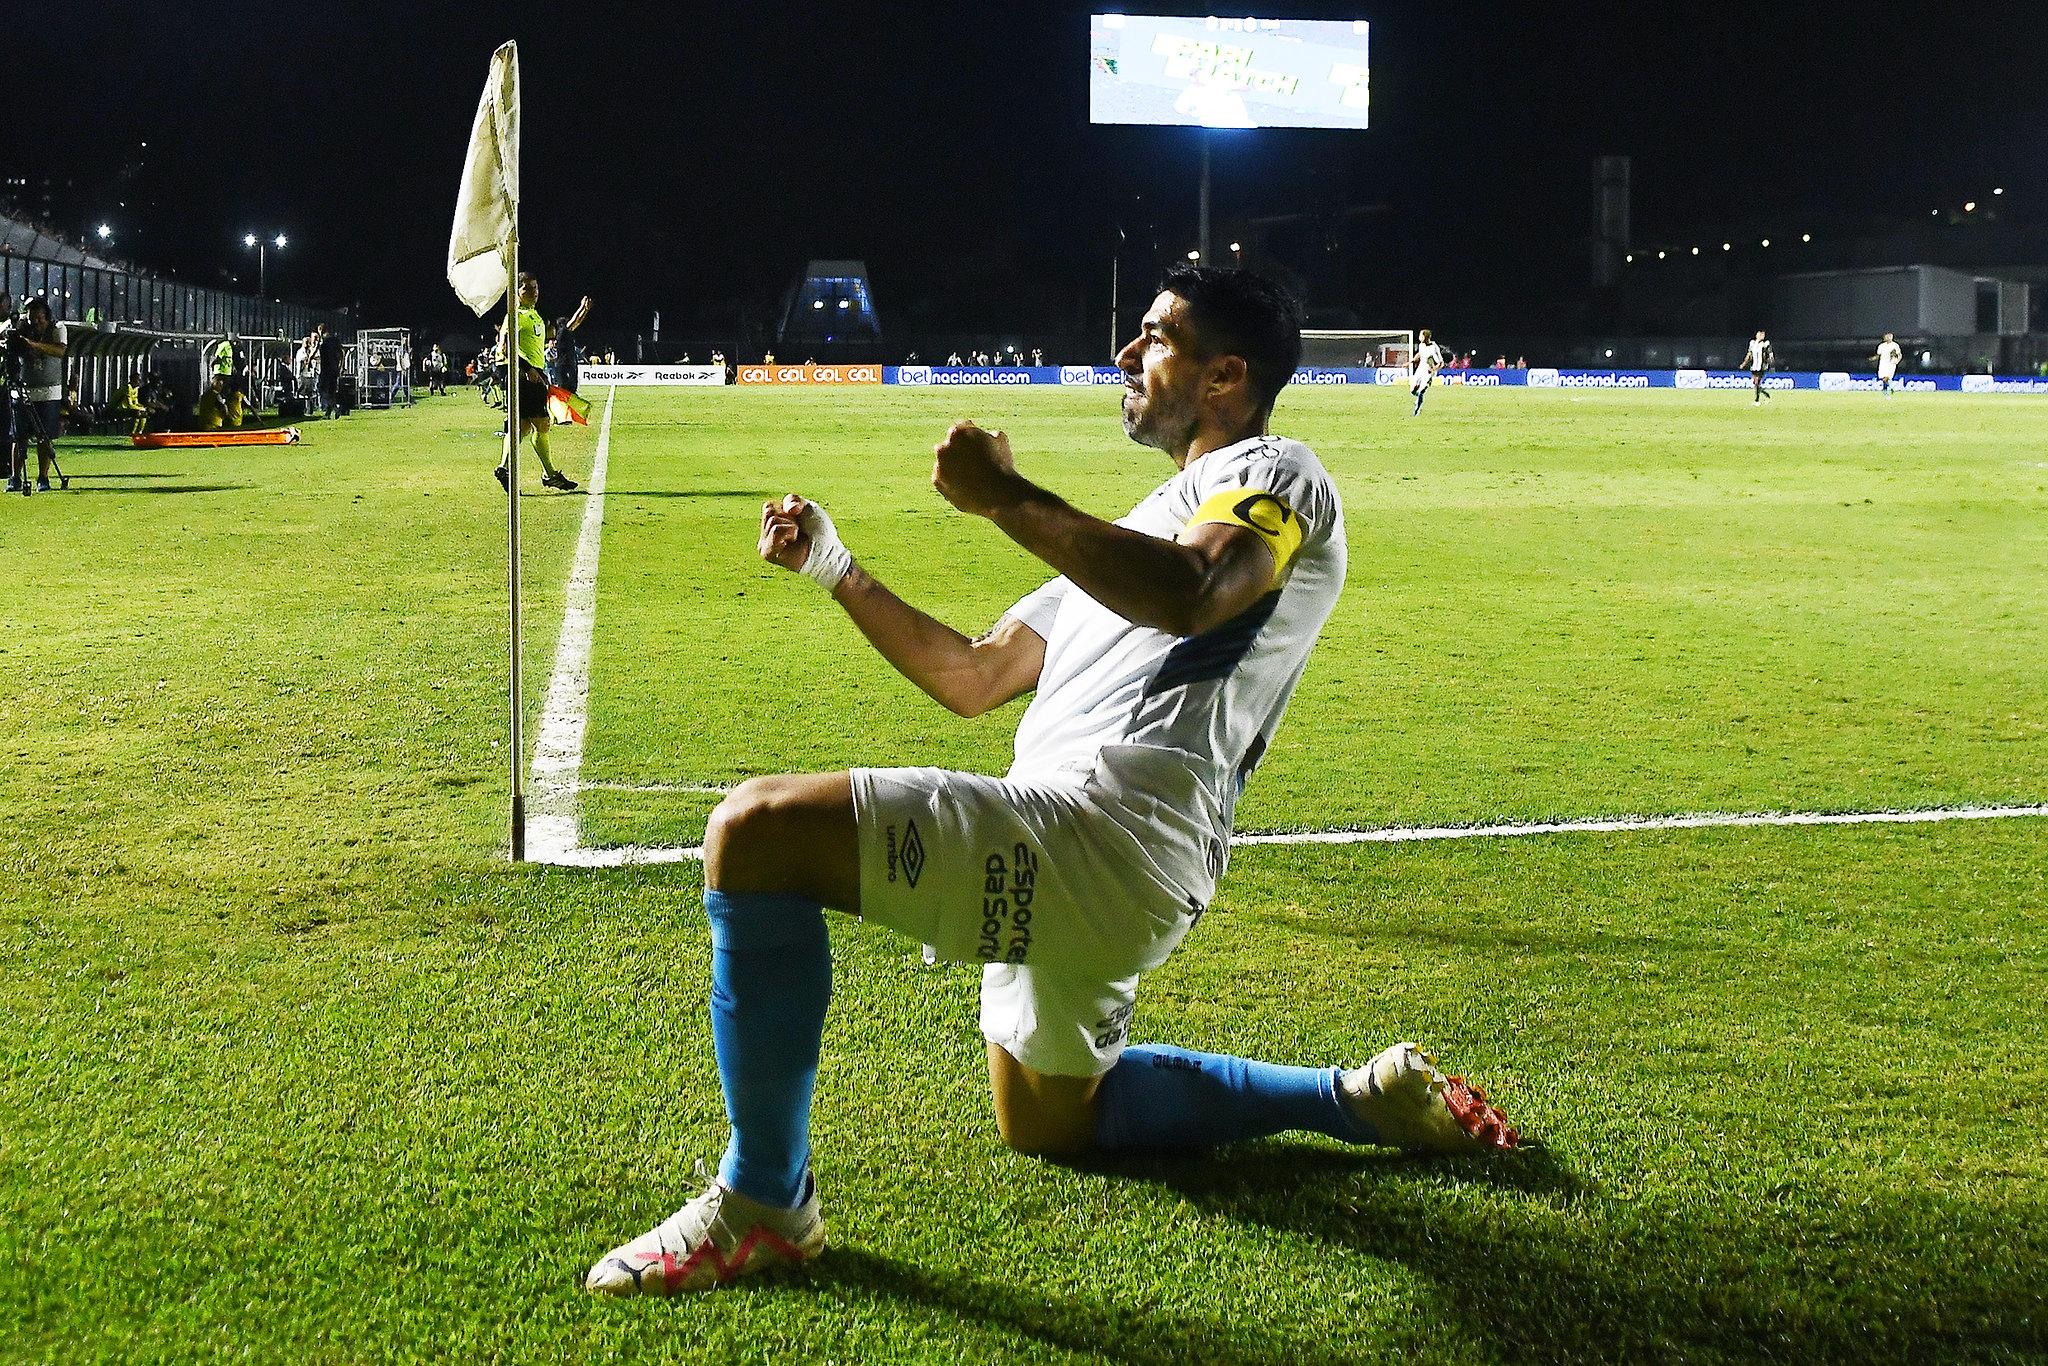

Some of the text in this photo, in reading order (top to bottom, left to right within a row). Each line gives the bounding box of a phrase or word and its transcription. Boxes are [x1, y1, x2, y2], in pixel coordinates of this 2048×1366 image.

[583, 371, 695, 380] Reebok Reebok
[901, 368, 1031, 384] betnacional.com
[1232, 494, 1292, 537] C
